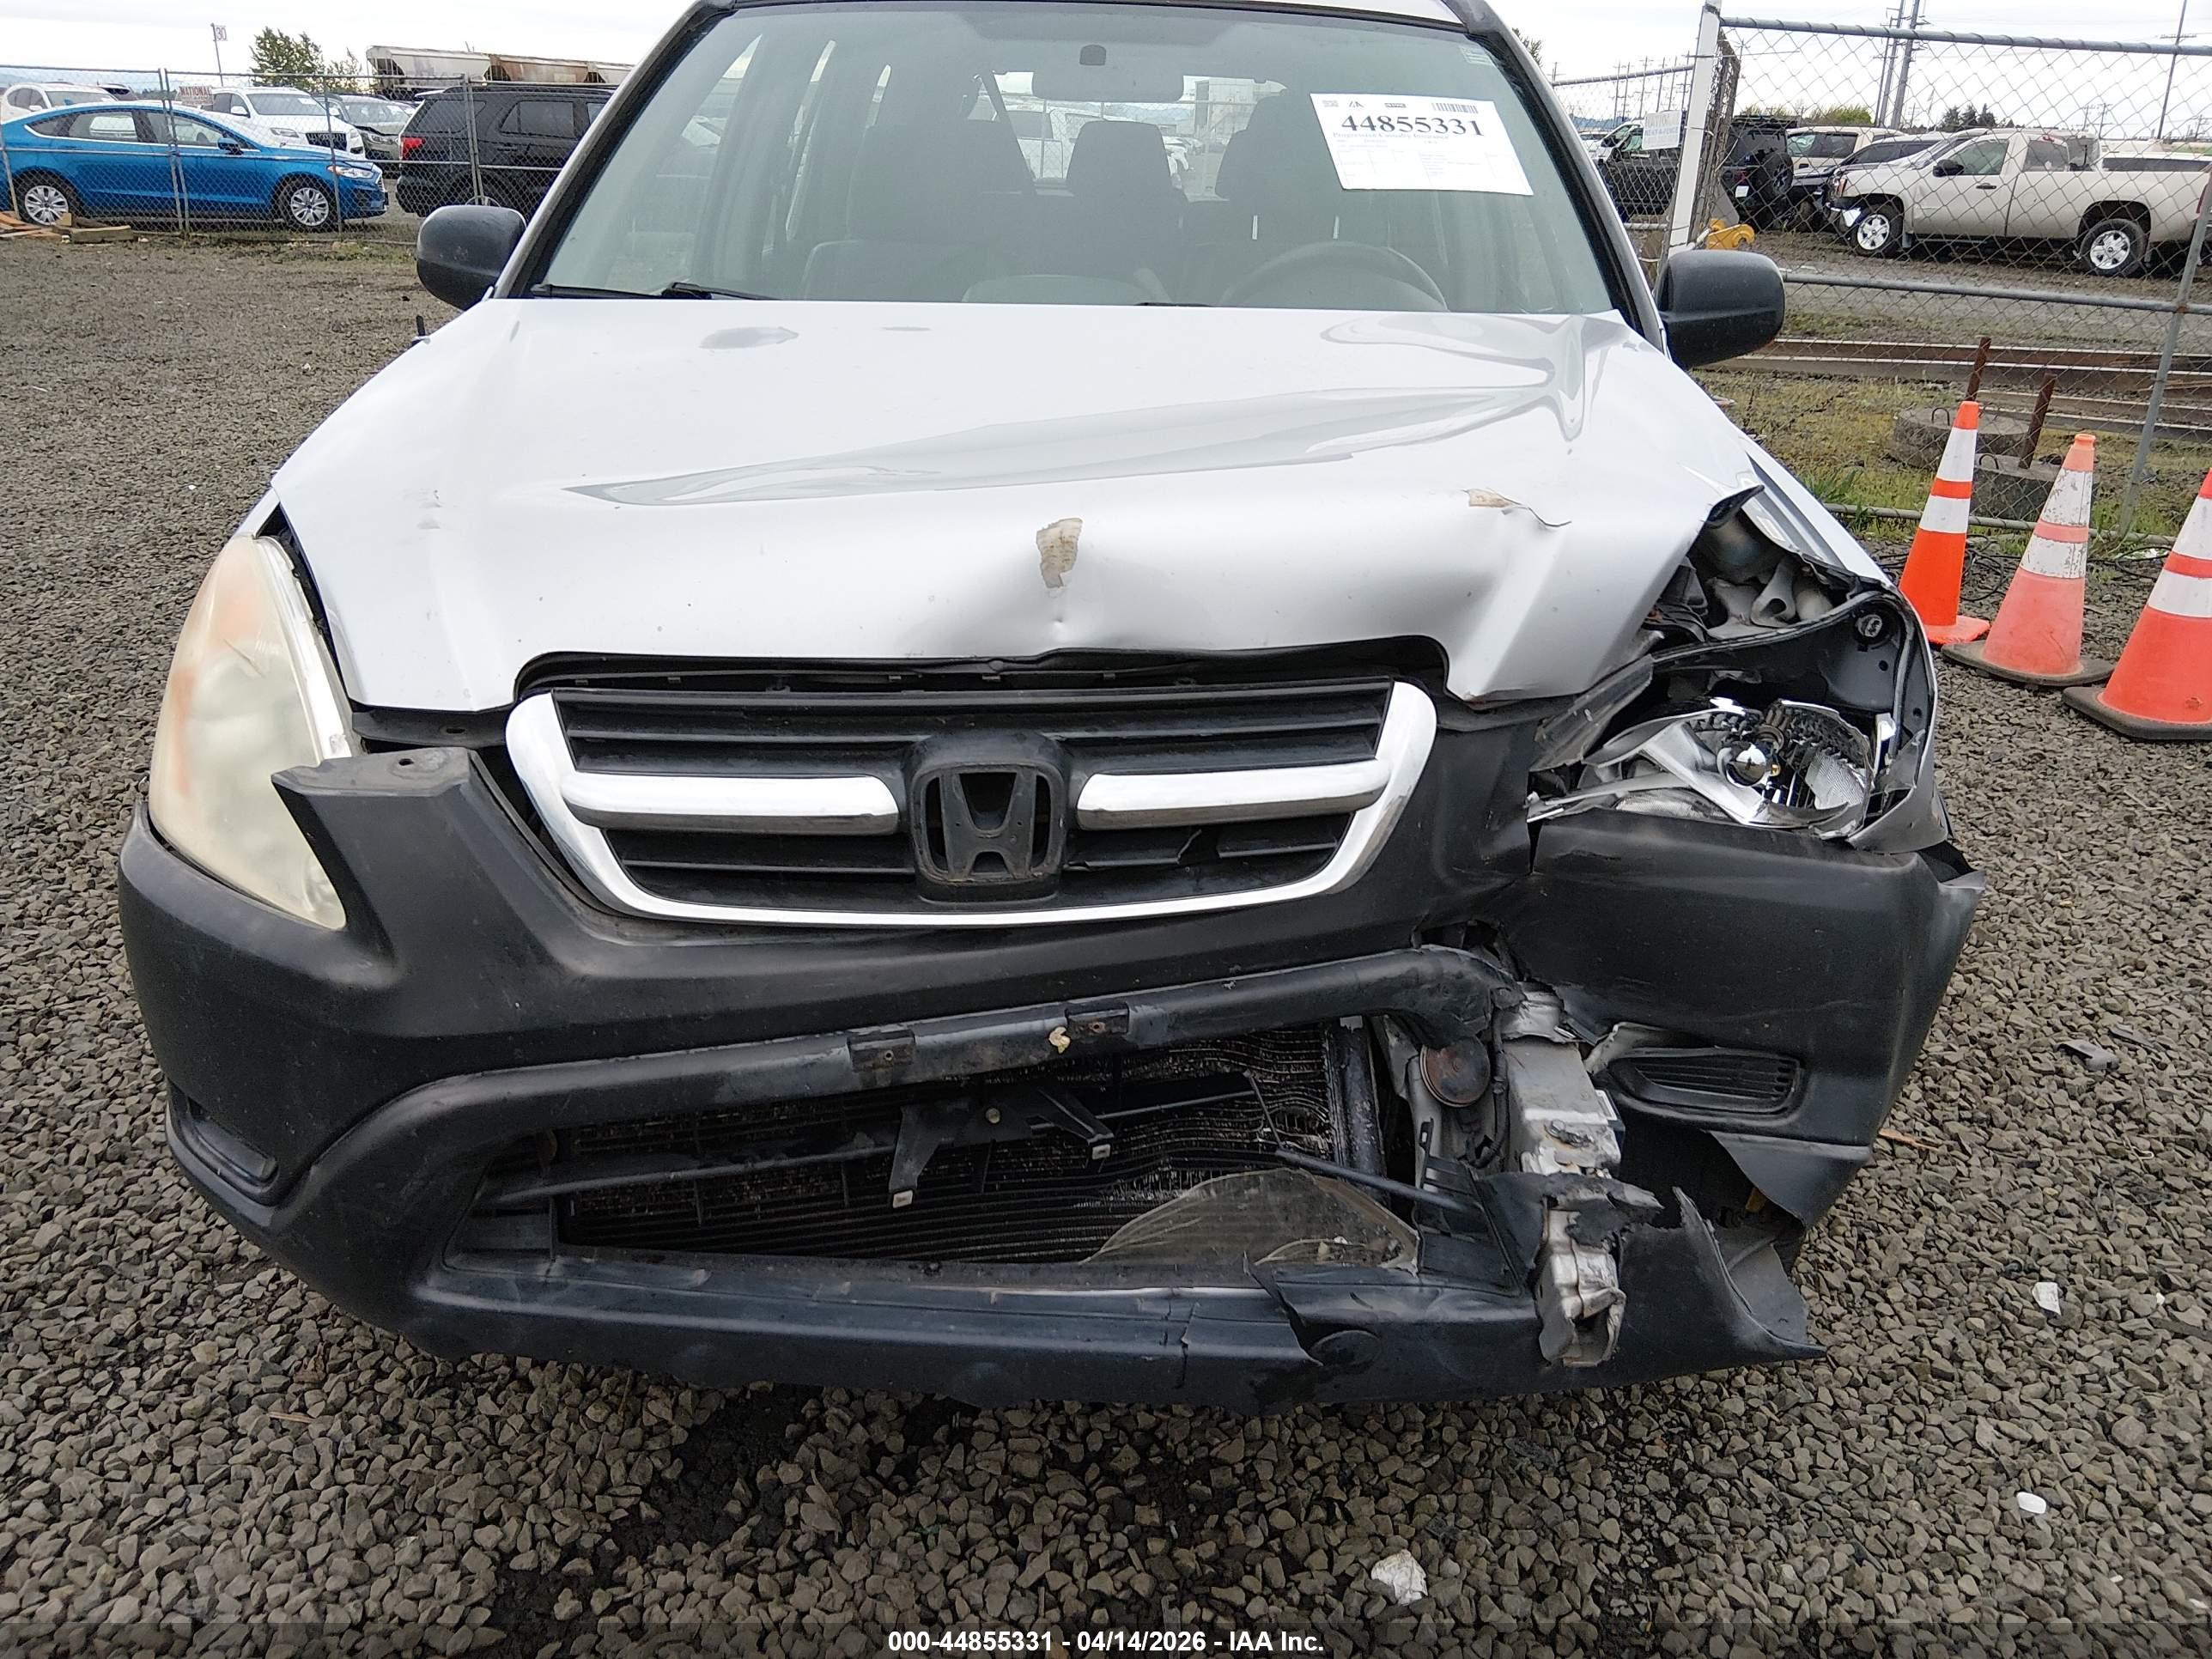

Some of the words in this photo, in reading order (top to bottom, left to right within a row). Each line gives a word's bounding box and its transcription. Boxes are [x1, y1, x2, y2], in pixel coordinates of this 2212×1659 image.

[216, 27, 228, 40] 30
[179, 85, 212, 96] NATIONAL
[1341, 114, 1485, 137] 44855331
